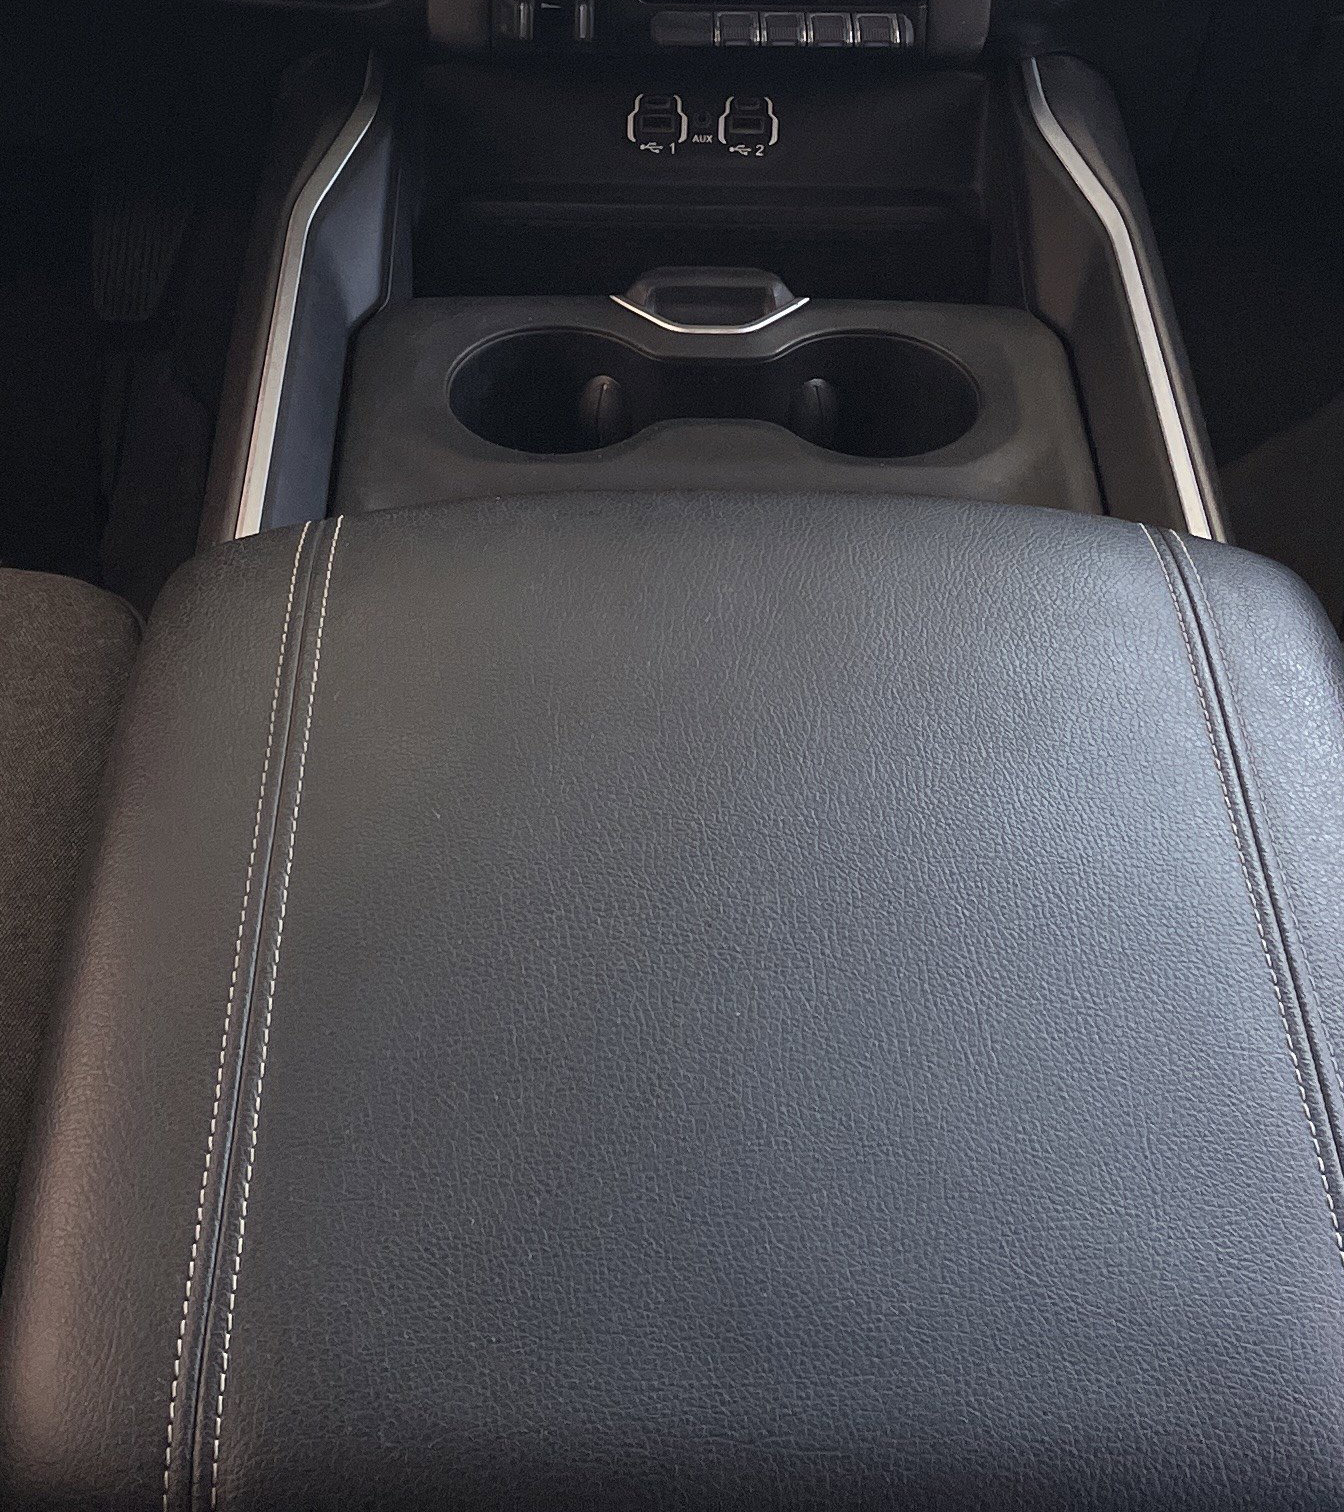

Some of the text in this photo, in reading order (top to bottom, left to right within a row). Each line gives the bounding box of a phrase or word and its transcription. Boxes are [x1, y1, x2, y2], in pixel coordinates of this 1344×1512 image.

[692, 135, 713, 143] AUX
[669, 143, 675, 154] 1
[755, 144, 765, 157] 2
